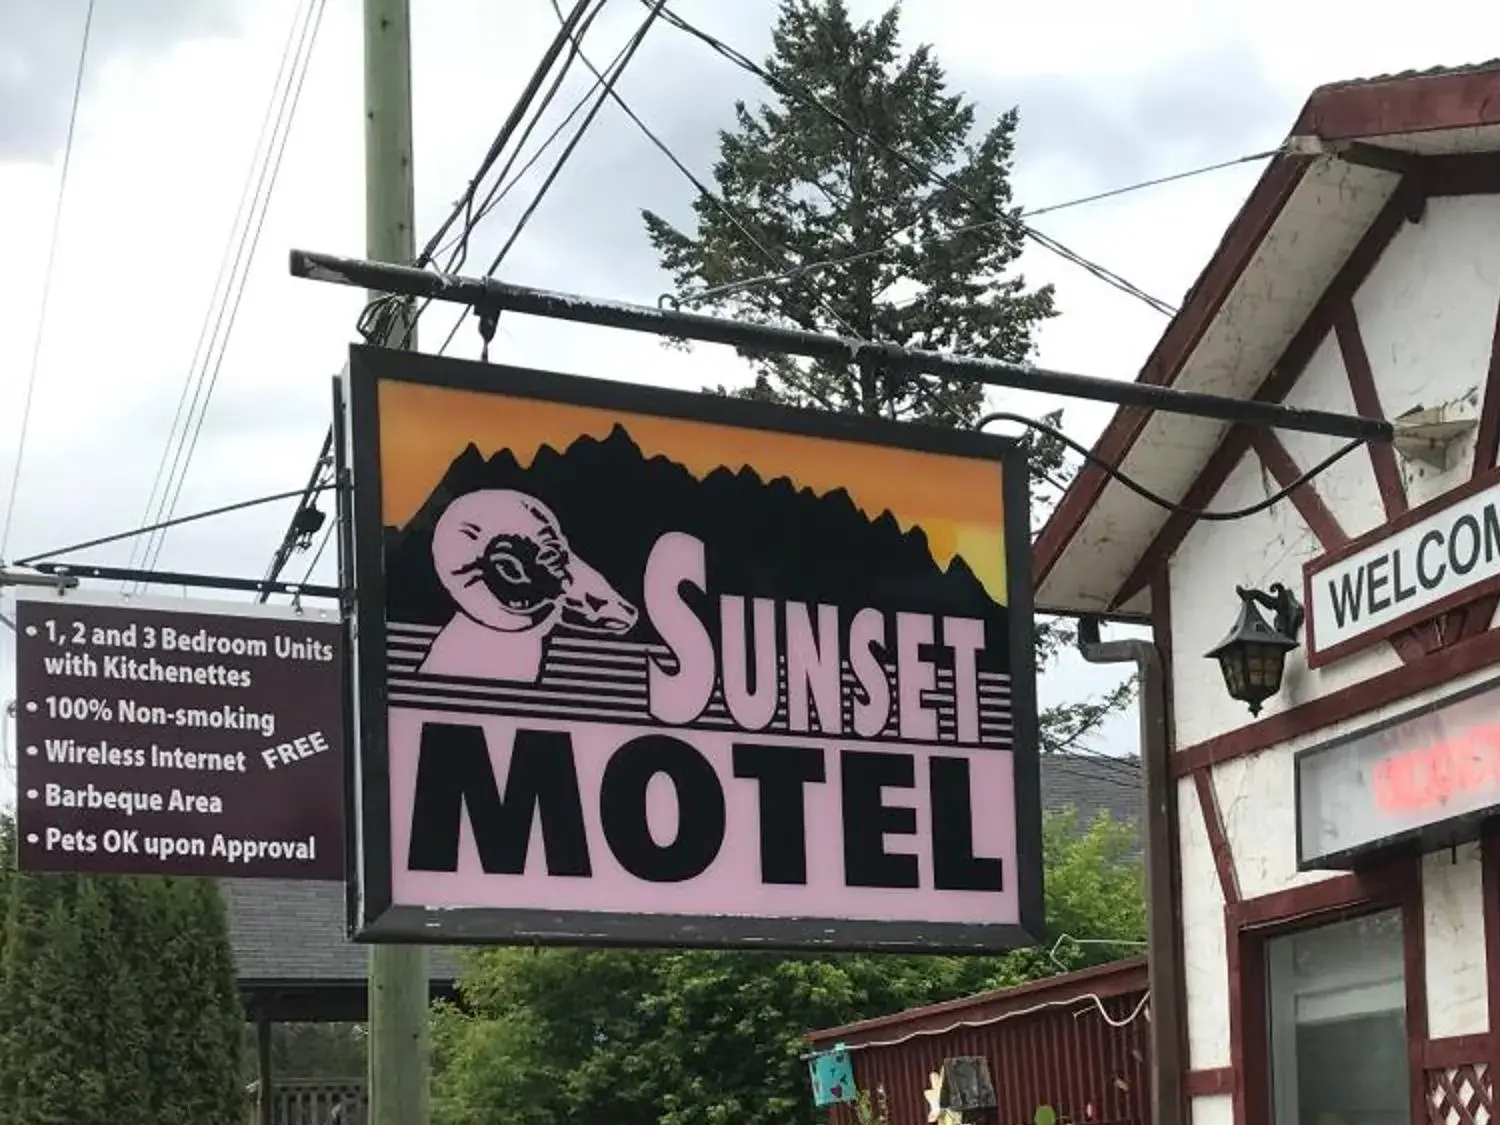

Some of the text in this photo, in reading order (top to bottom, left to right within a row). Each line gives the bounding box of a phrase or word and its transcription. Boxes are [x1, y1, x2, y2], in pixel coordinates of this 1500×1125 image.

[45, 620, 333, 661] 1, 2 and 3 Bedroom Units
[644, 532, 985, 743] SUNSET
[44, 652, 251, 687] with Kitchenettes
[45, 696, 275, 737] 100% Non-smoking
[45, 740, 247, 772] Wireless Internet
[261, 731, 330, 770] FREE
[45, 783, 223, 816] Barbeque Area
[407, 722, 1003, 892] MOTEL
[45, 827, 316, 863] Pets OK upon Approval
